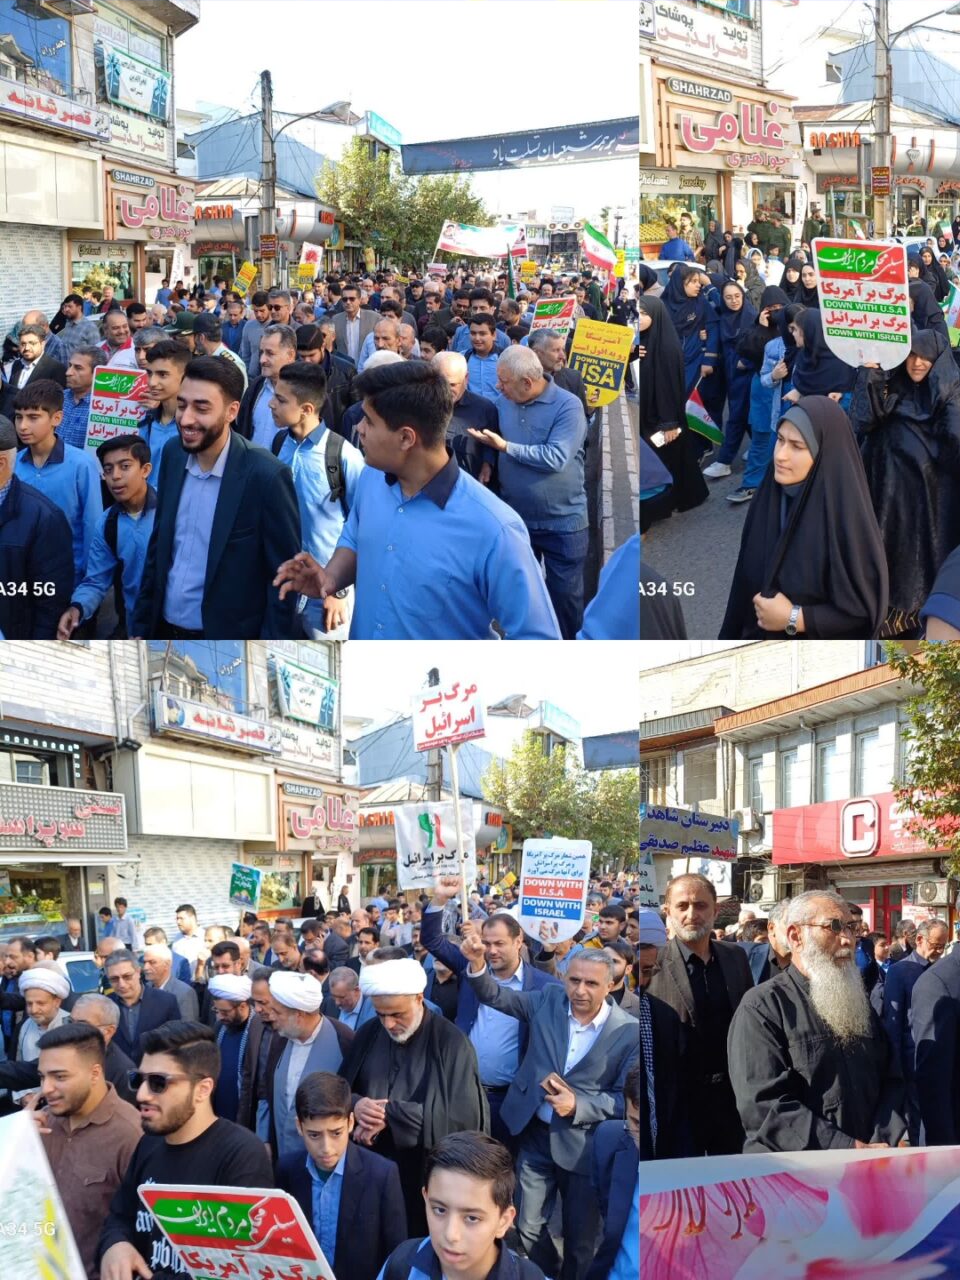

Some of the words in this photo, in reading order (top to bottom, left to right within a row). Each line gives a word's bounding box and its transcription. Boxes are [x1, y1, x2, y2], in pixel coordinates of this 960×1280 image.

[655, 4, 695, 33] پوشاک
[657, 27, 749, 59] فخرالدین
[723, 26, 749, 44] تولید
[671, 79, 731, 102] SHAHRZAD
[8, 91, 58, 116] شانه
[59, 110, 93, 126] قصر
[680, 100, 786, 154] غلامی
[727, 151, 788, 170] جواهری
[114, 170, 155, 188] SHAHRZAD
[119, 183, 192, 229] غلامی
[821, 281, 863, 300] آمریکا
[864, 290, 878, 303] بر
[879, 286, 907, 305] مرگ
[825, 300, 854, 311] DOWN
[855, 303, 879, 313] WITH
[880, 305, 904, 315] U.S.A
[826, 312, 867, 328] اسرائیل
[868, 318, 881, 330] بر
[882, 317, 908, 332] مرگ
[828, 328, 857, 339] DOWN
[857, 331, 878, 341] WITH
[878, 333, 907, 343] ISRAEL
[576, 355, 599, 366] DOWN
[600, 359, 621, 370] WITH
[573, 358, 617, 388] USA
[92, 399, 120, 415] آمریکا
[92, 415, 111, 423] DOWN
[112, 417, 127, 425] WITH
[444, 682, 478, 703] مرگ
[419, 692, 443, 713] بر
[192, 711, 236, 734] شانه
[425, 705, 476, 739] اسرائیل
[284, 782, 322, 798] SHAHRZAD
[291, 792, 356, 839] غلامی
[647, 808, 679, 823] شاهد
[681, 812, 730, 834] دبیرستان
[640, 834, 679, 851] صدیقی
[680, 840, 711, 857] عظیم
[403, 851, 434, 868] اسرائیل
[711, 845, 738, 861] شهید
[525, 879, 555, 888] DOWN
[557, 880, 584, 890] WITH
[539, 888, 564, 897] U.S.A
[524, 898, 554, 908] DOWN
[555, 900, 582, 910] WITH
[534, 907, 566, 918] ISRAEL
[180, 1249, 253, 1278] آمریکا
